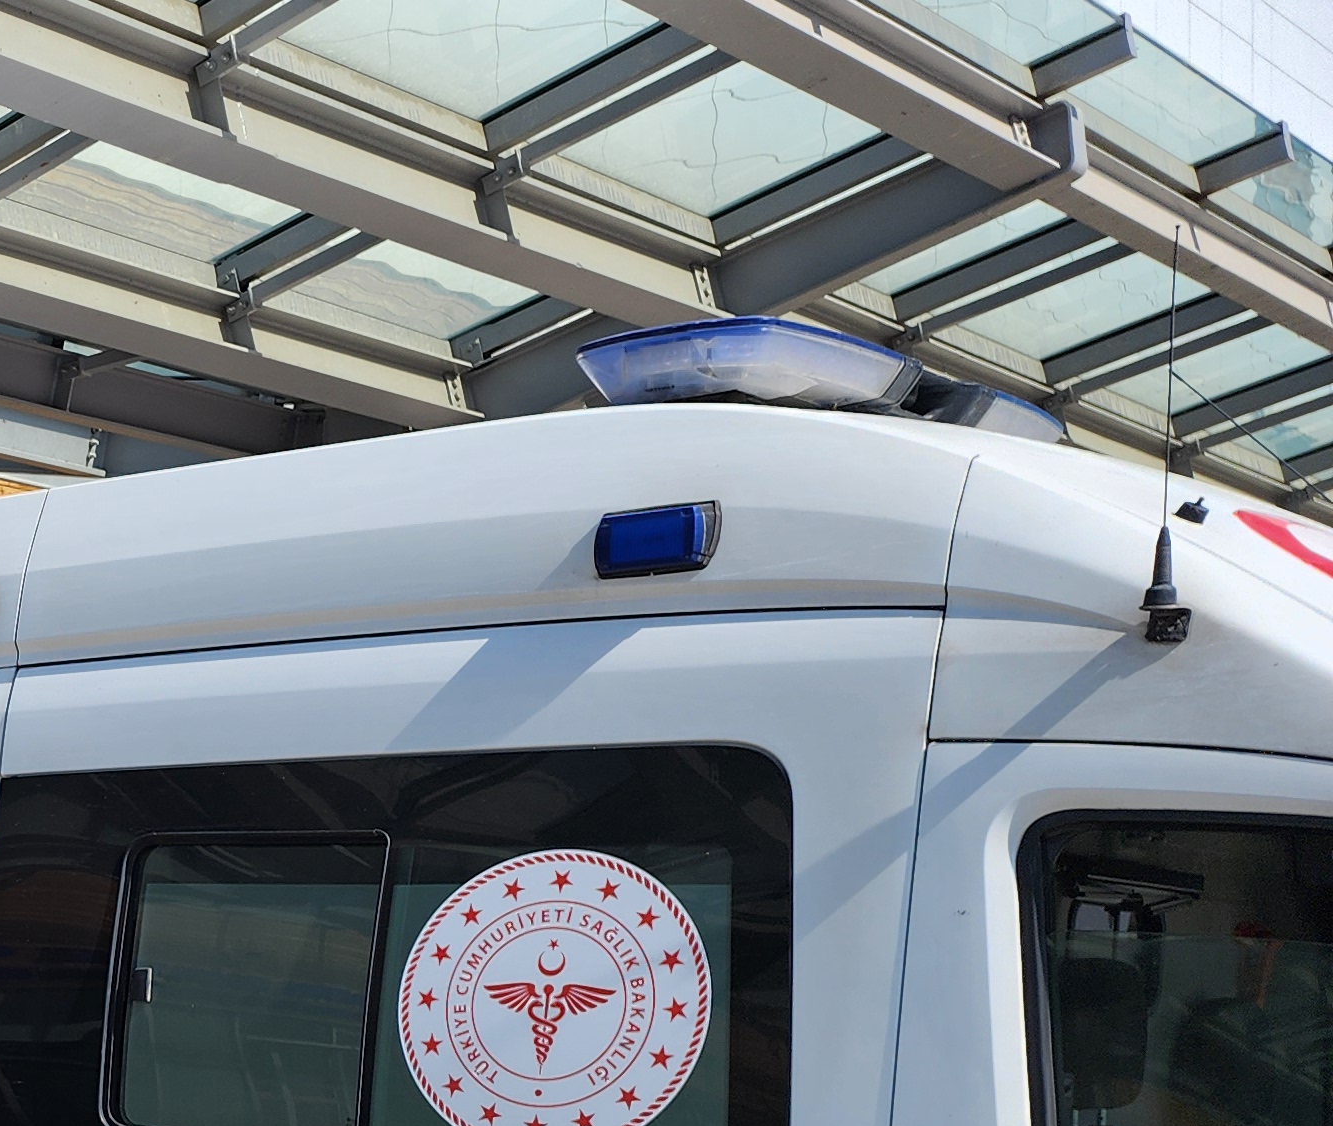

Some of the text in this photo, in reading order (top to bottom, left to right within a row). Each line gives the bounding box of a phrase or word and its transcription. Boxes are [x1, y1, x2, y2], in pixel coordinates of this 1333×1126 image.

[453, 906, 646, 1086] TÜRKİYE CUMHURİYETİ SAĞLIK BAKANLIĞI
